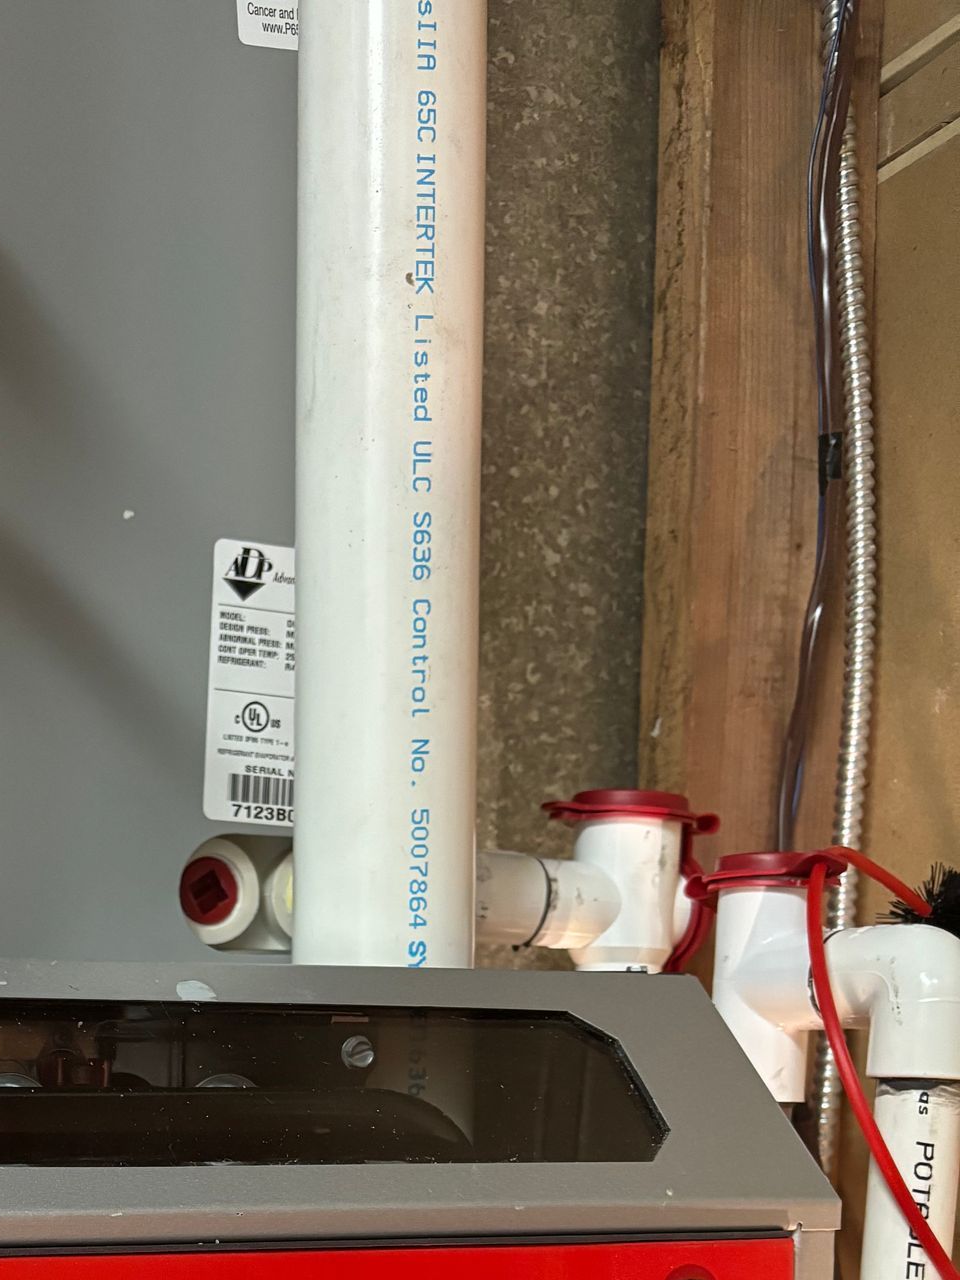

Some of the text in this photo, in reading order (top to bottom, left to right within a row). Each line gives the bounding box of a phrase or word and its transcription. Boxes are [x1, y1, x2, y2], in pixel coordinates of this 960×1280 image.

[247, 2, 276, 18] Cancer
[279, 8, 294, 20] and
[416, 90, 436, 143] 65C
[415, 153, 436, 295] INTERTEK
[413, 314, 434, 422] Listed
[412, 441, 432, 493] ULC
[224, 546, 273, 581] ADP
[412, 511, 432, 581] S636
[411, 599, 431, 718] Control
[245, 765, 284, 776] SERIAL
[410, 738, 430, 787] No.
[408, 808, 430, 930] 5007864
